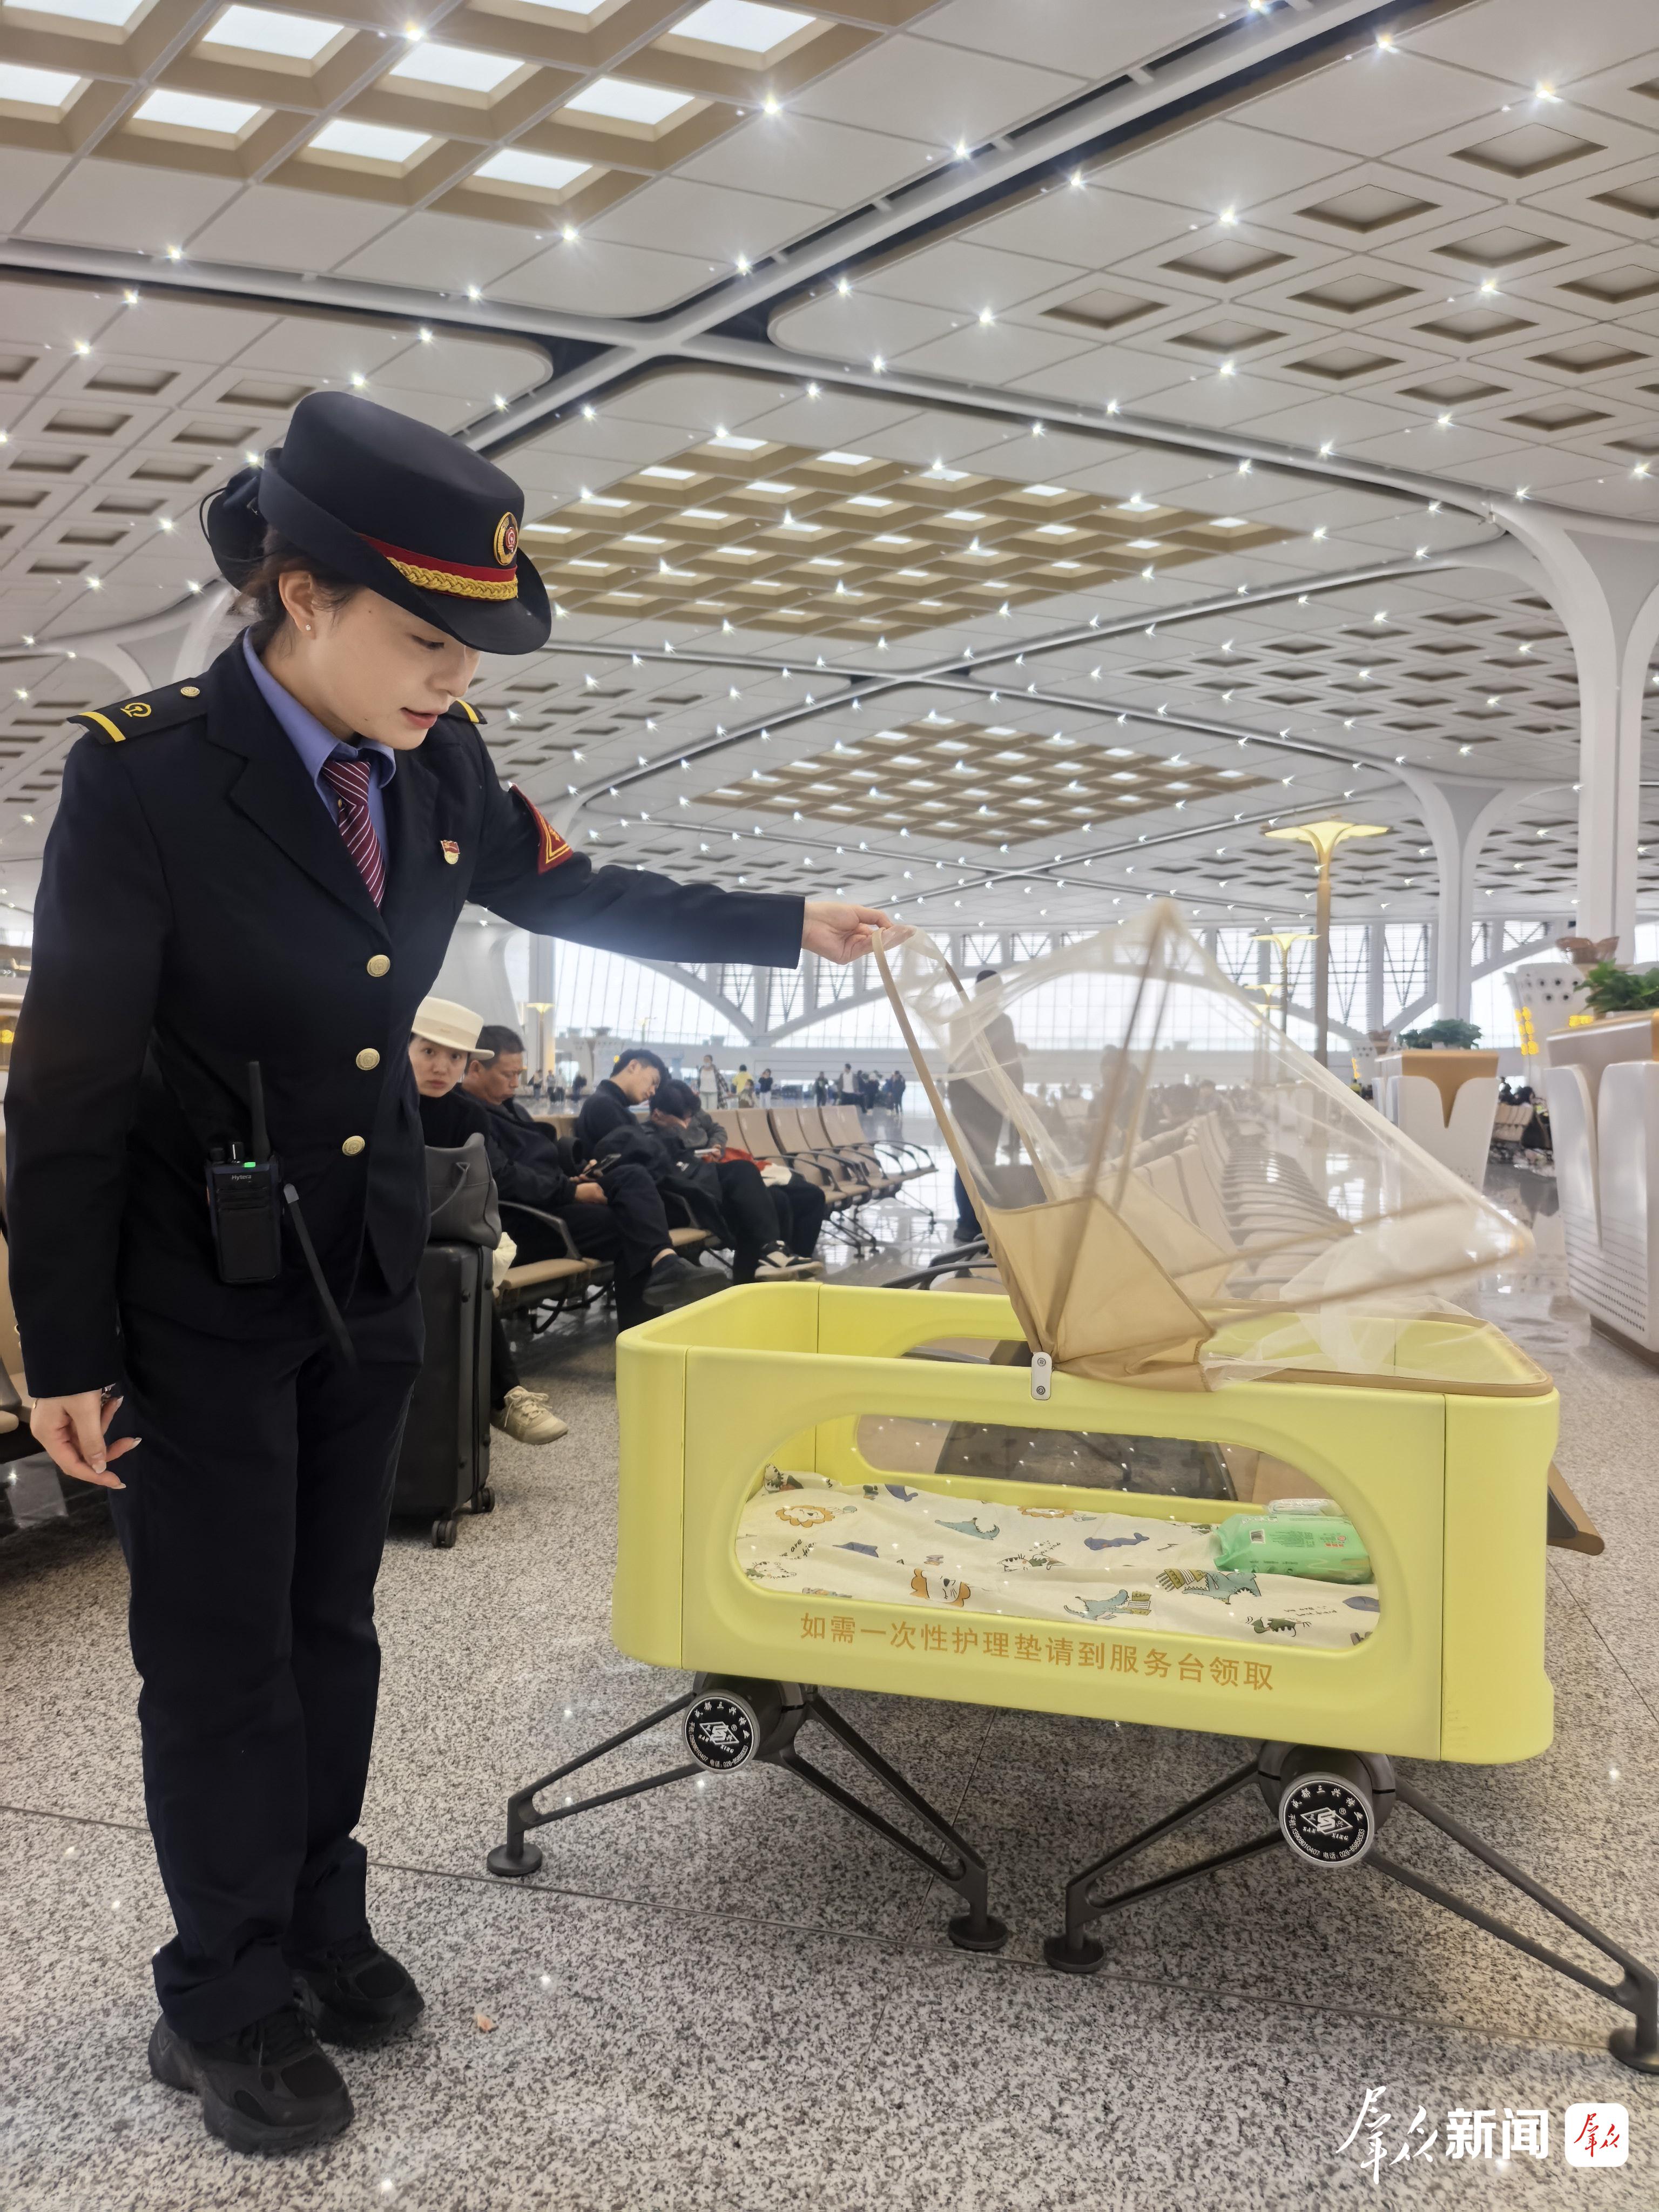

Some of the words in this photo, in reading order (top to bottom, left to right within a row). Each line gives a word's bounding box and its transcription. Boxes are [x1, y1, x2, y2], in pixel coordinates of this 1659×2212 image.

[800, 1612, 1274, 1691] 如需一次性护理垫请到服务台领取
